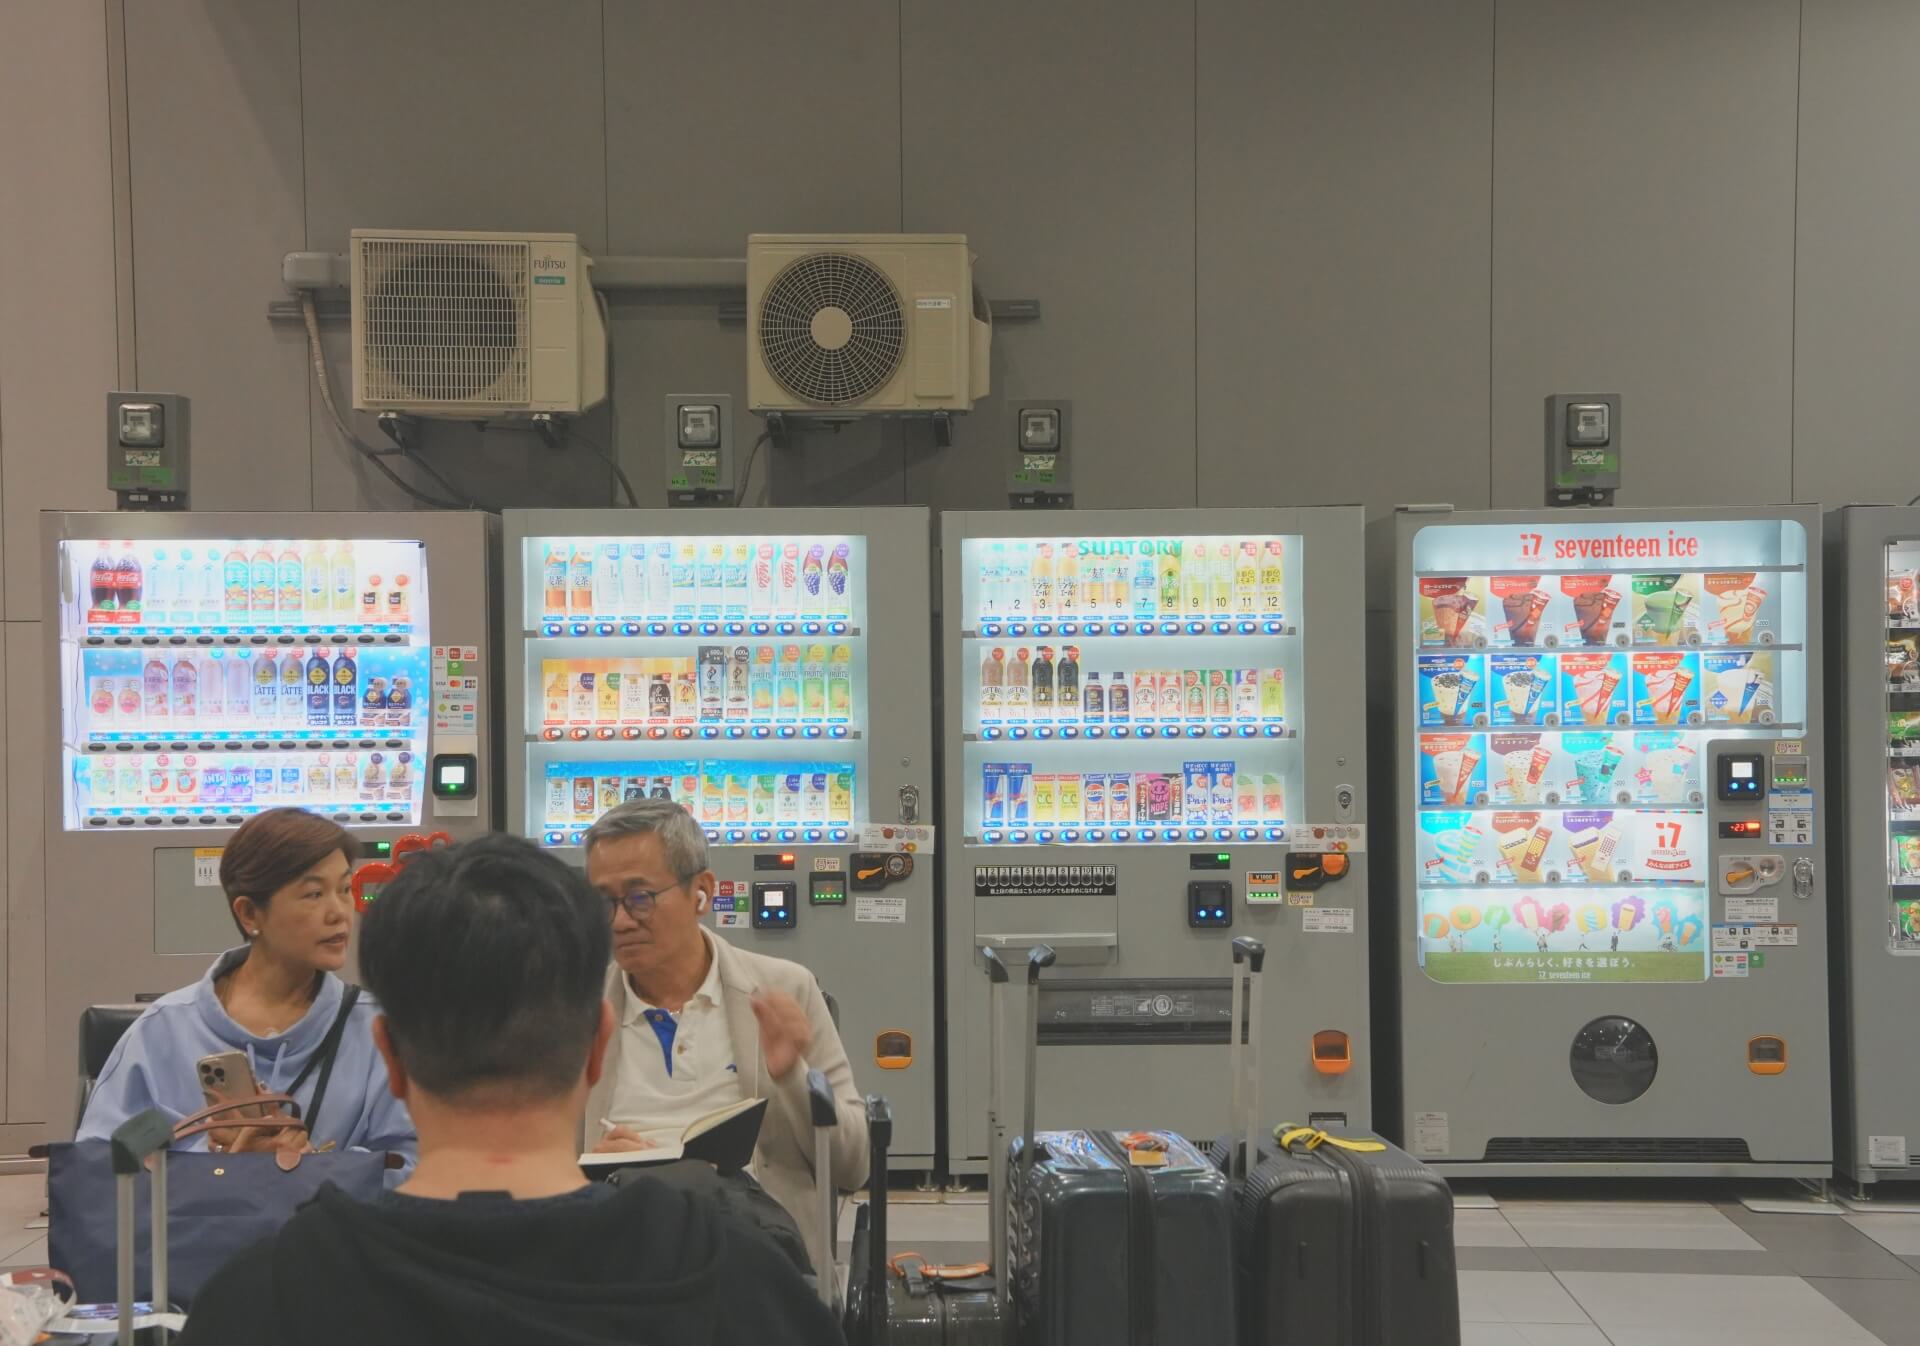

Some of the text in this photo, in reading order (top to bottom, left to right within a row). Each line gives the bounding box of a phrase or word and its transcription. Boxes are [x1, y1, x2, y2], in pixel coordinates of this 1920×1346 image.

[534, 257, 566, 270] FUJITSU
[1555, 529, 1698, 559] seventeen ice
[254, 686, 276, 695] LATTE
[281, 686, 303, 695] LATTE
[307, 685, 329, 694] BLACK
[333, 685, 356, 694] BLACK
